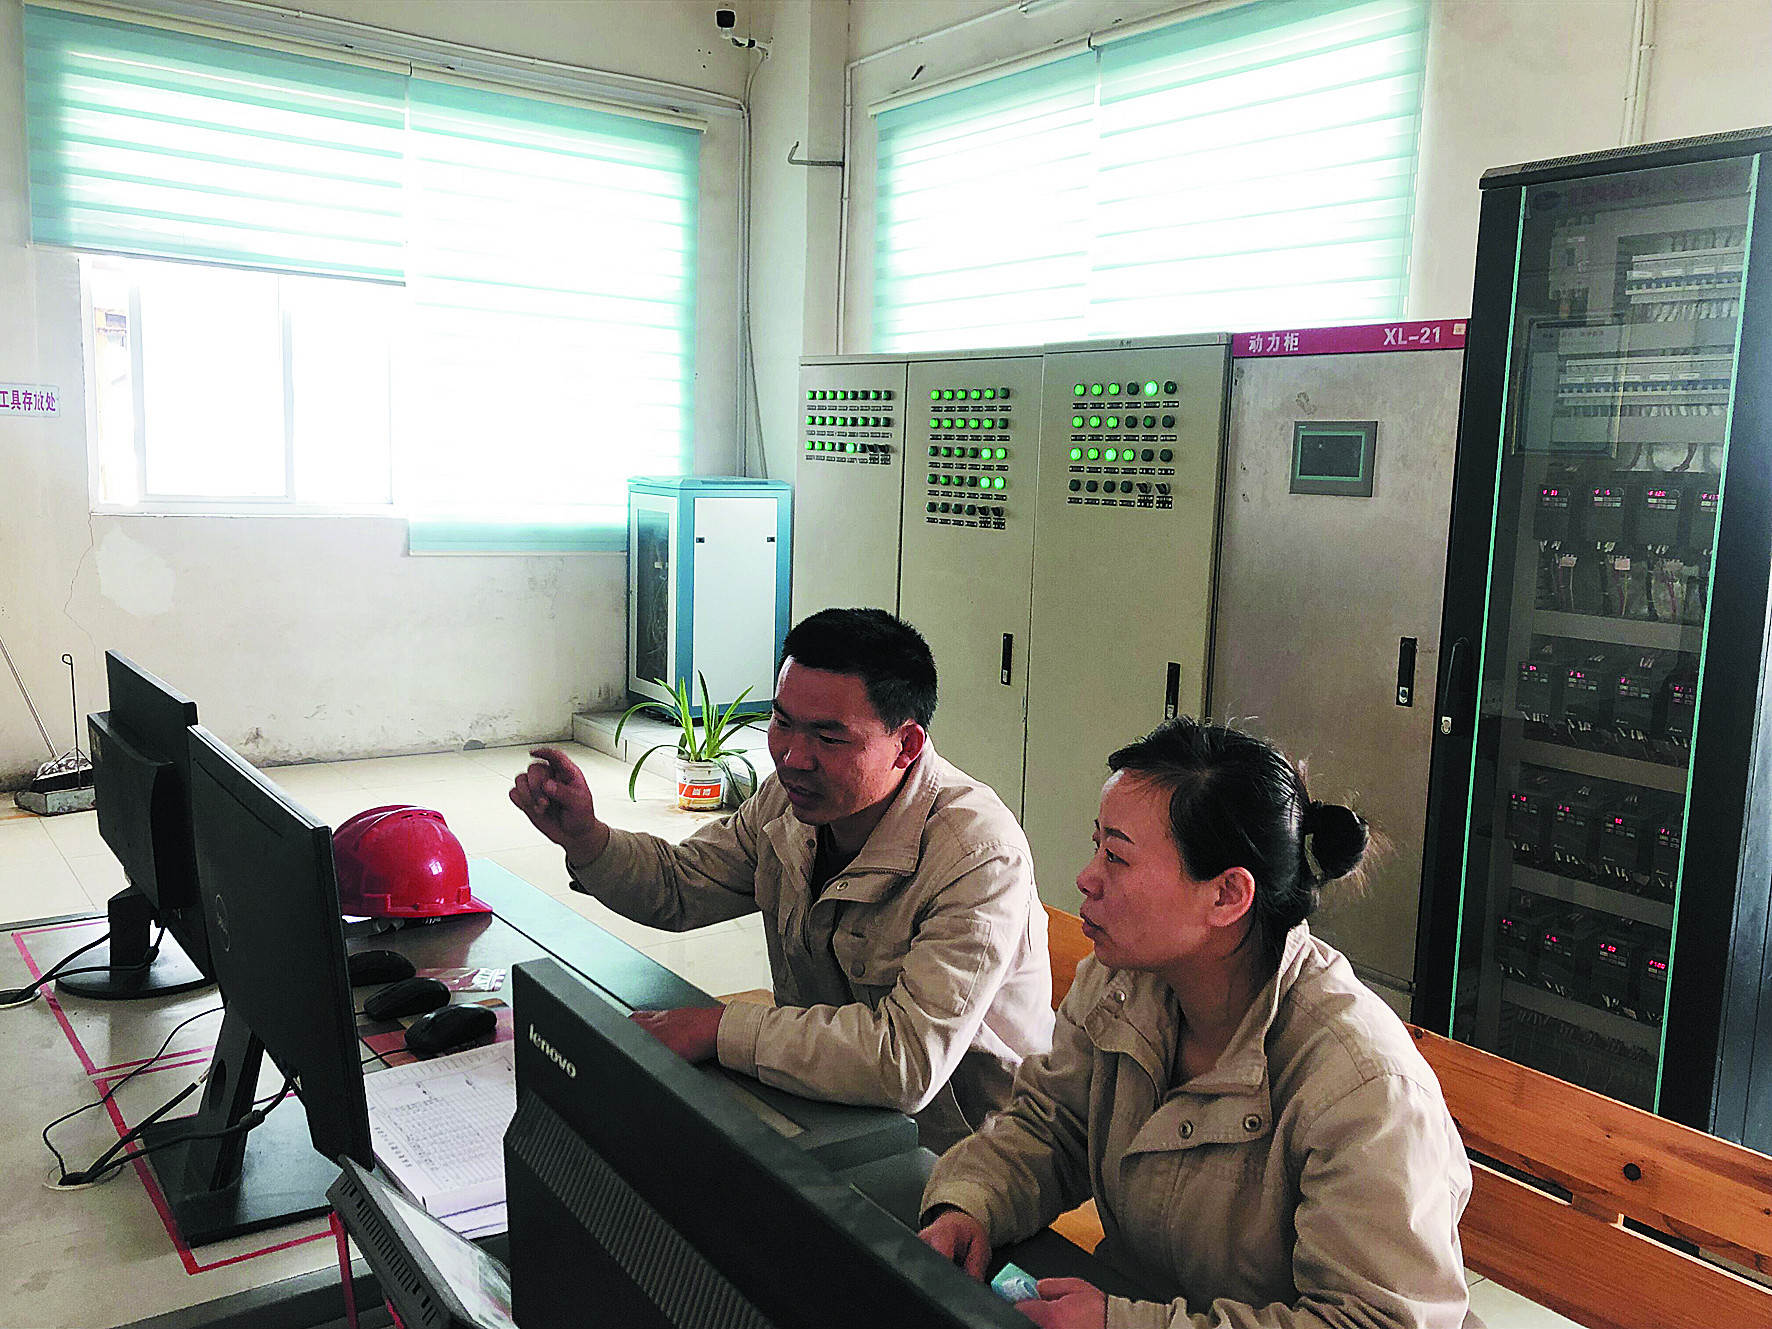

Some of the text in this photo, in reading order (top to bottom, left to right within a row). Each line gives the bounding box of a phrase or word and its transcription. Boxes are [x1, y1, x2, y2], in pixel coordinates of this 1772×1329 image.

[1248, 332, 1300, 352] 动力柜
[1383, 326, 1441, 346] XL-21
